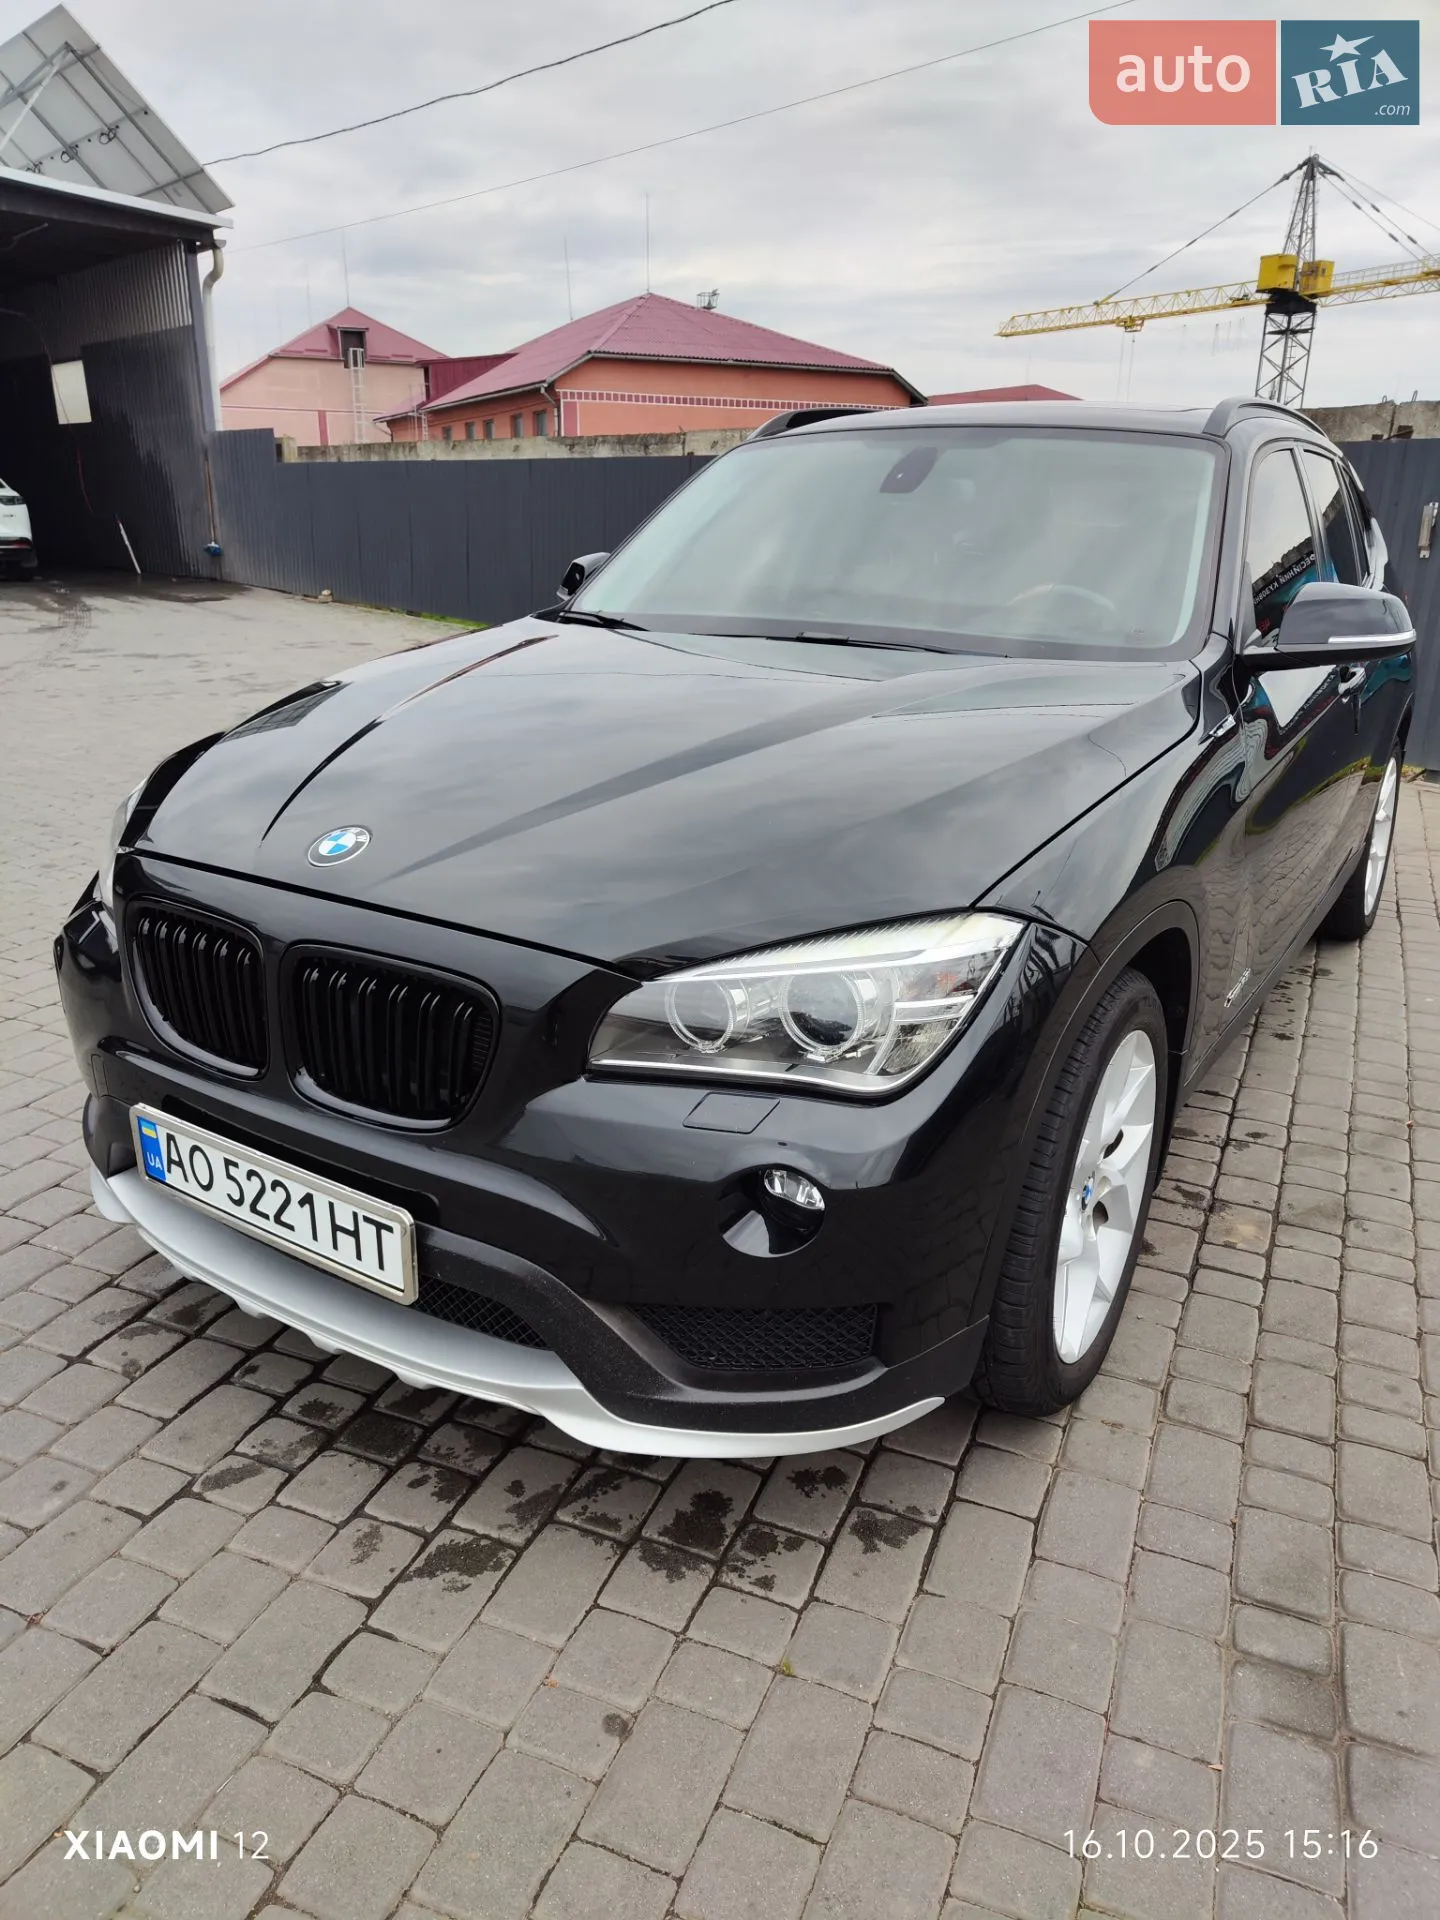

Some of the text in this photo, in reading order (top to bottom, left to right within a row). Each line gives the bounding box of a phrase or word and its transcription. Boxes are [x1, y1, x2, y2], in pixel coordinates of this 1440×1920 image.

[147, 1152, 163, 1171] UA
[166, 1132, 394, 1272] AO 5221 HT
